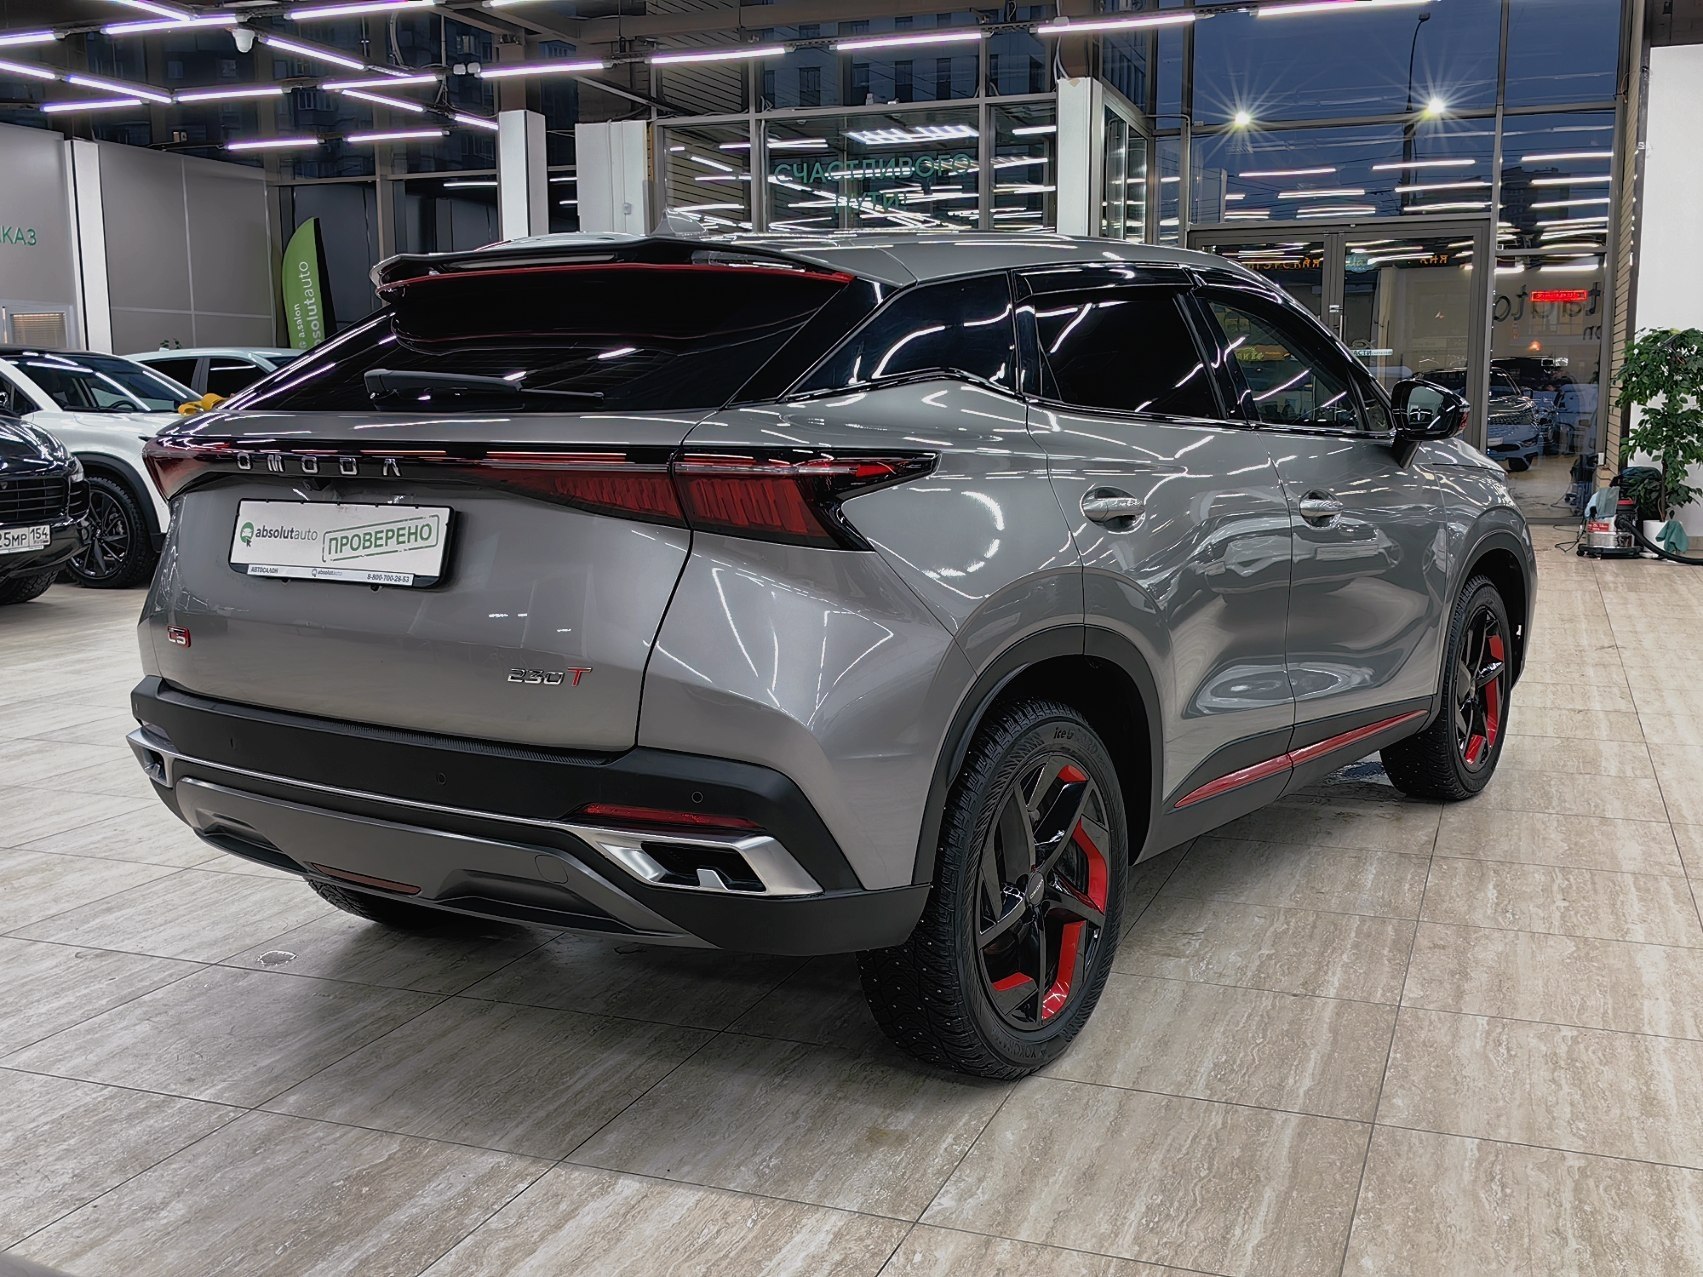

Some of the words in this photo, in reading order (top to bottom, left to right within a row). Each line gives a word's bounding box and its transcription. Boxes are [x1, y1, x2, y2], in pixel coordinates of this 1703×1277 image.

[773, 153, 972, 184] СЧАСТЛИВОГО
[0, 225, 37, 246] КАЗ
[30, 526, 49, 540] 154
[255, 524, 318, 541] absolutauto
[328, 523, 433, 555] ПРОВЕРЕНО
